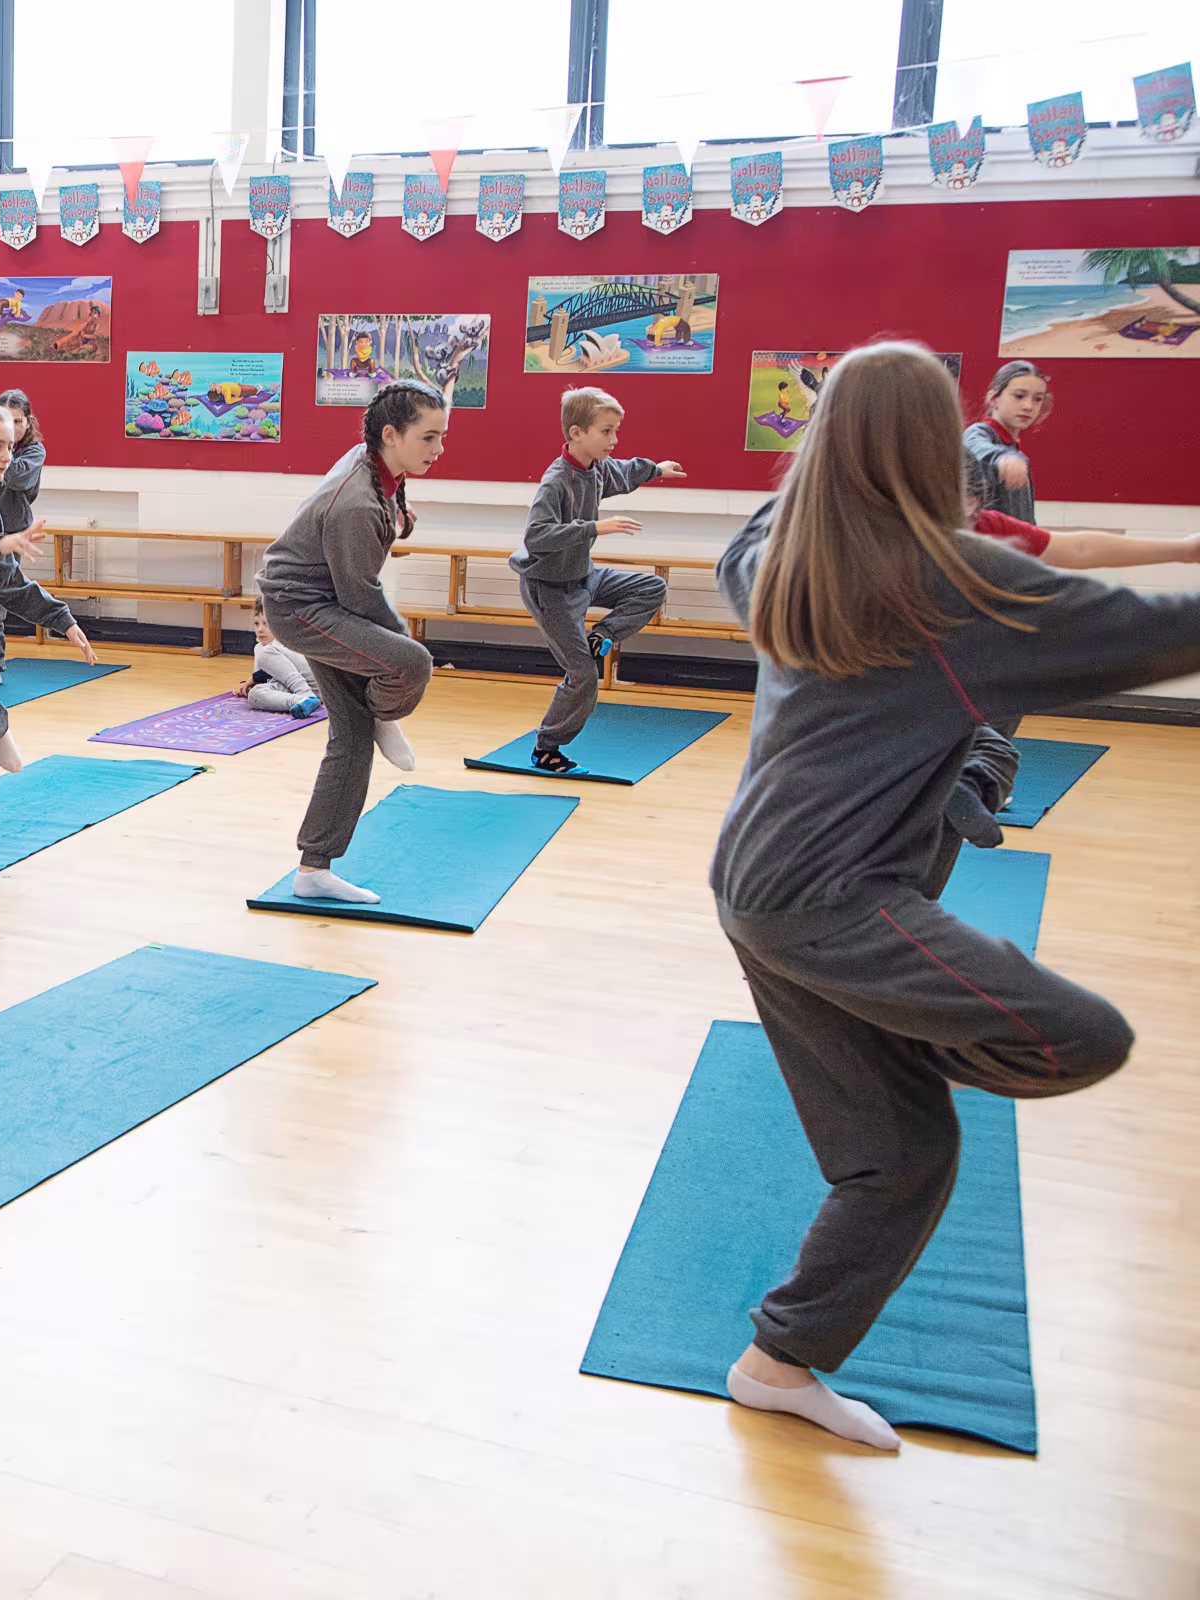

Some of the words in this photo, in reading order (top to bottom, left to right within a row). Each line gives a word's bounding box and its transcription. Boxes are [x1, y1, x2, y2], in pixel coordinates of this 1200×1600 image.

[831, 147, 881, 166] Nollaig
[934, 146, 982, 166] Shona
[734, 161, 780, 181] Nollaig
[833, 165, 881, 183] Shona
[561, 178, 603, 197] Nollaig
[645, 172, 690, 190] Nollaig
[734, 181, 779, 197] Shona
[62, 191, 96, 206] Nollaig
[252, 182, 288, 199] Nollaig
[481, 181, 522, 200] Nollaig
[647, 190, 689, 206] Shona
[2, 196, 34, 212] Nollaig
[252, 197, 287, 212] Shona
[332, 196, 368, 208] Shona
[407, 198, 443, 212] Shona
[481, 198, 520, 212] Shona
[562, 196, 601, 210] Shona
[2, 211, 33, 224] Shona
[63, 207, 95, 220] Shona
